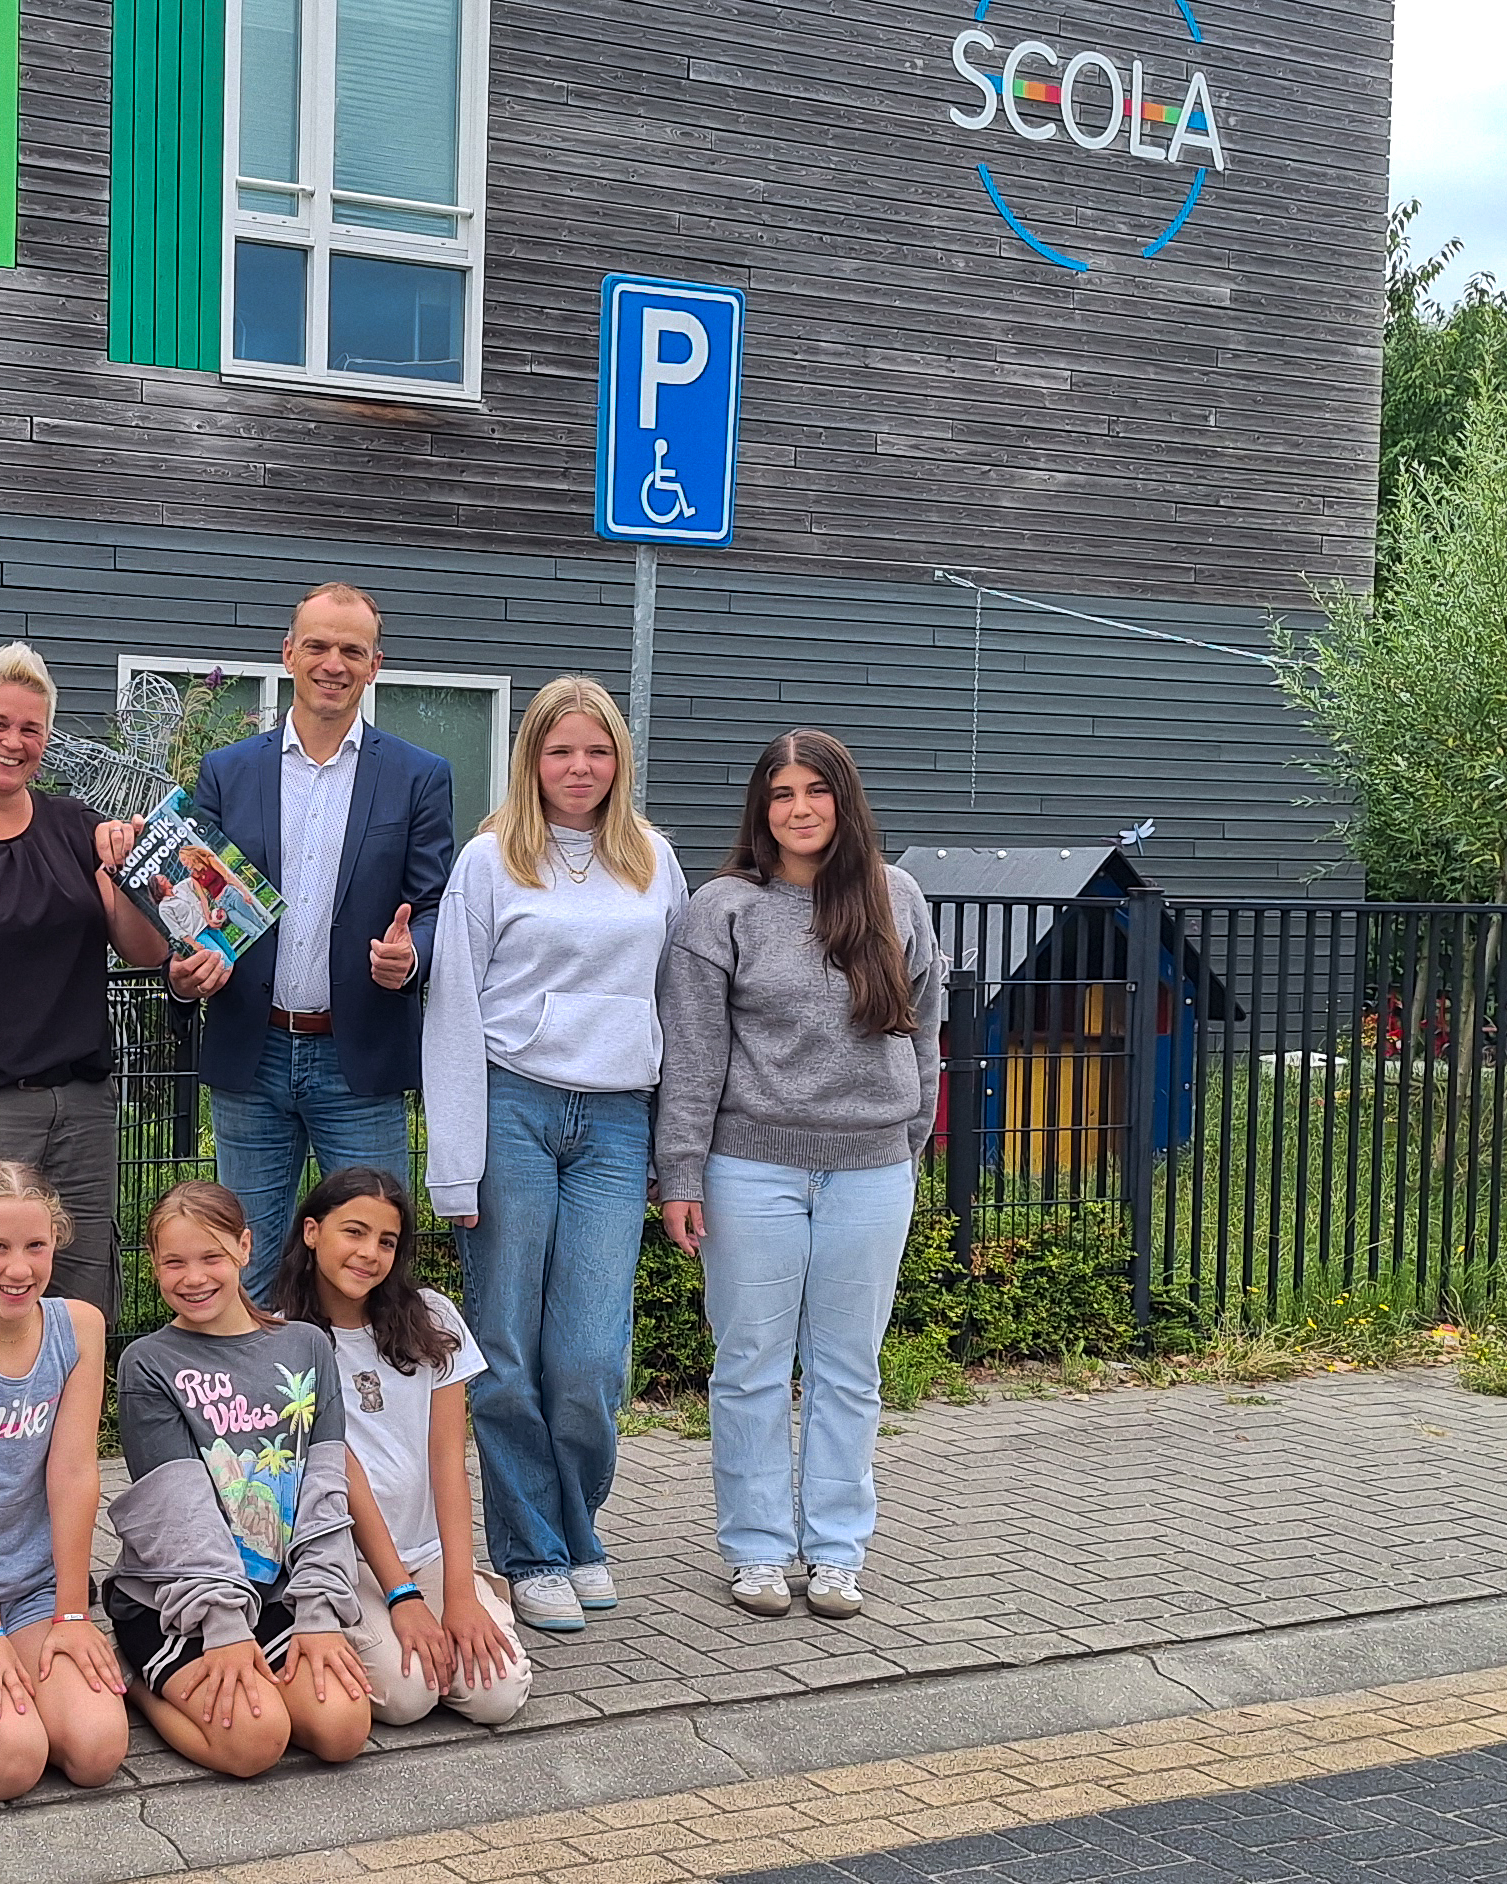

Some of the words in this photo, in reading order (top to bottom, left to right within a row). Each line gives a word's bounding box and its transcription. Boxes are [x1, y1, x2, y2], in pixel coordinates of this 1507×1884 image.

[949, 29, 1225, 172] SCOLA
[639, 306, 709, 430] P
[128, 817, 198, 889] opgroeien
[175, 1369, 233, 1409] Rio
[203, 1394, 279, 1436] Vibes
